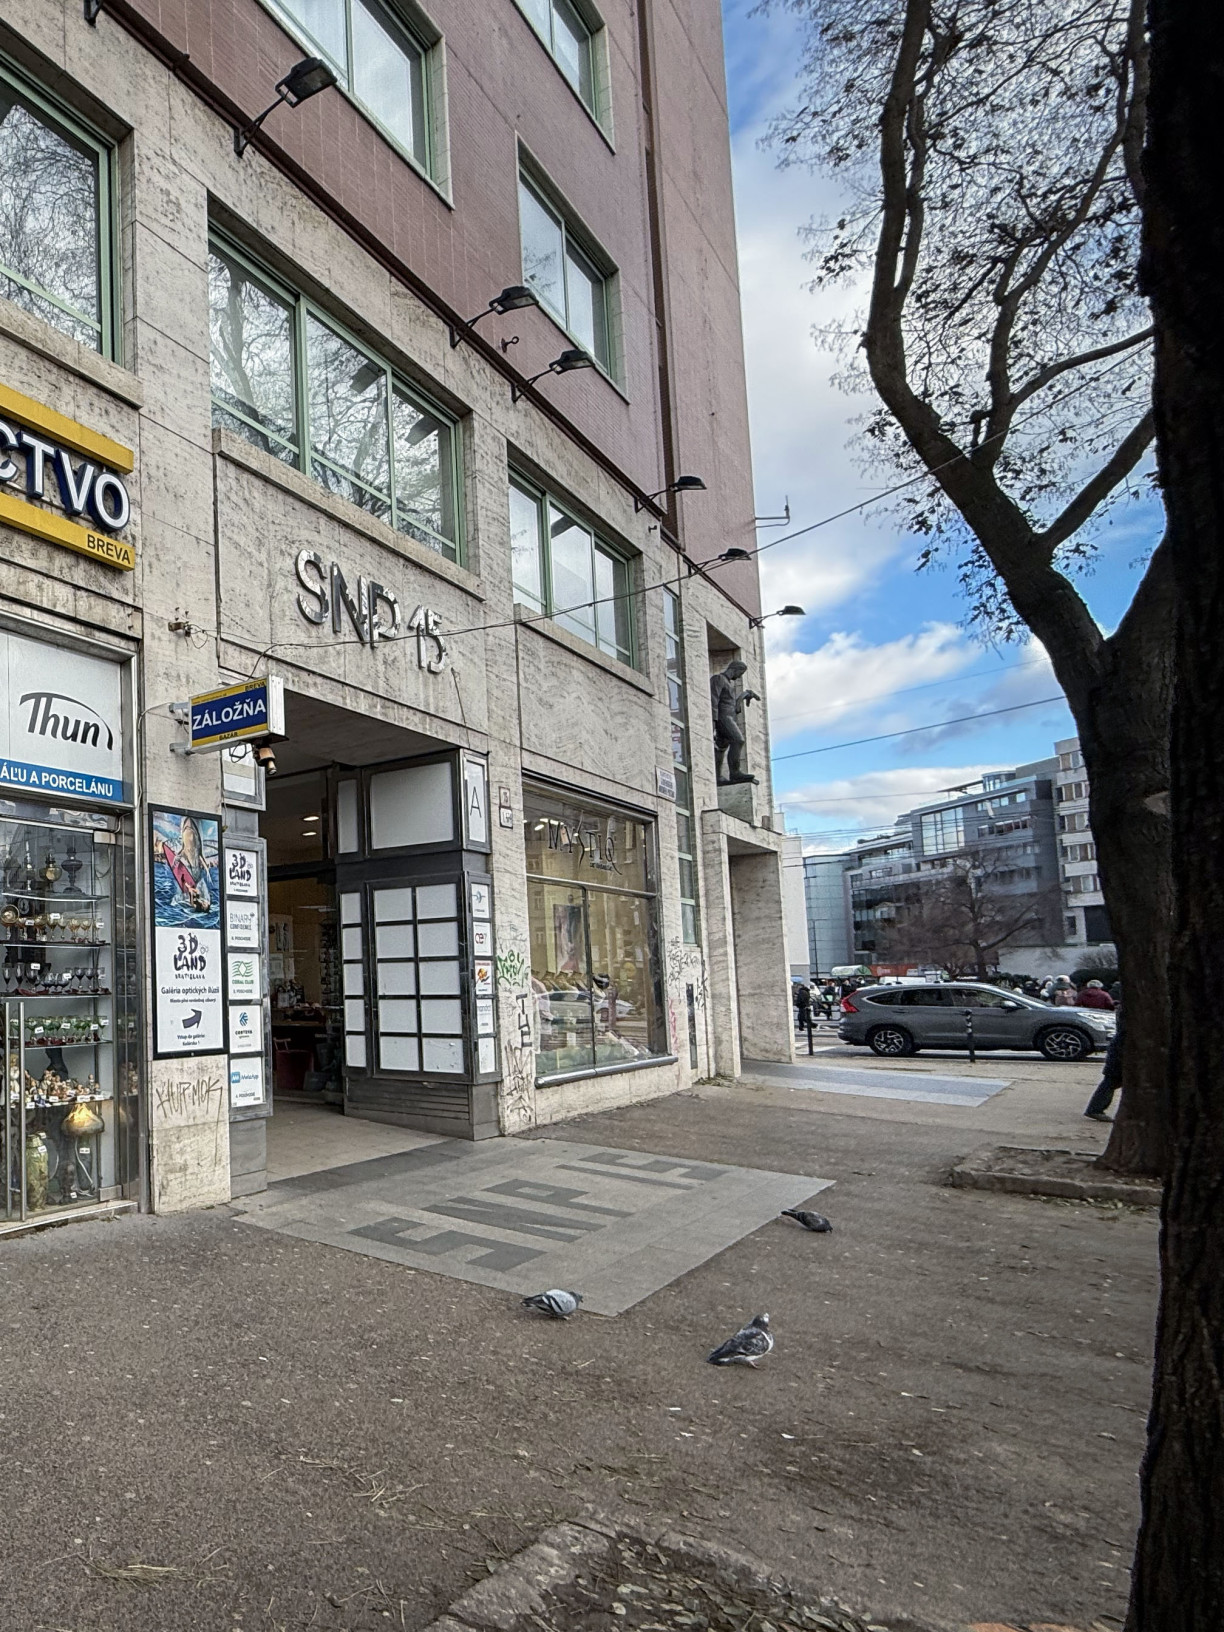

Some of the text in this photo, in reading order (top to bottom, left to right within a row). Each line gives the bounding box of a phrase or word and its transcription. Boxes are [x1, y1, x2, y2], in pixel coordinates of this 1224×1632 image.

[86, 533, 132, 566] BREVA
[407, 605, 448, 675] 15
[244, 681, 265, 691] BREVA
[19, 692, 113, 751] Thun
[192, 698, 266, 730] ZÁLOŽŇA
[29, 769, 39, 785] A
[41, 771, 113, 797] PORCELÁNU
[470, 786, 482, 818] A
[232, 853, 246, 869] 3D
[229, 867, 251, 881] LAND
[177, 933, 199, 955] 3D
[174, 955, 206, 972] LAND
[161, 986, 181, 994] Galéria
[182, 986, 207, 996] optických
